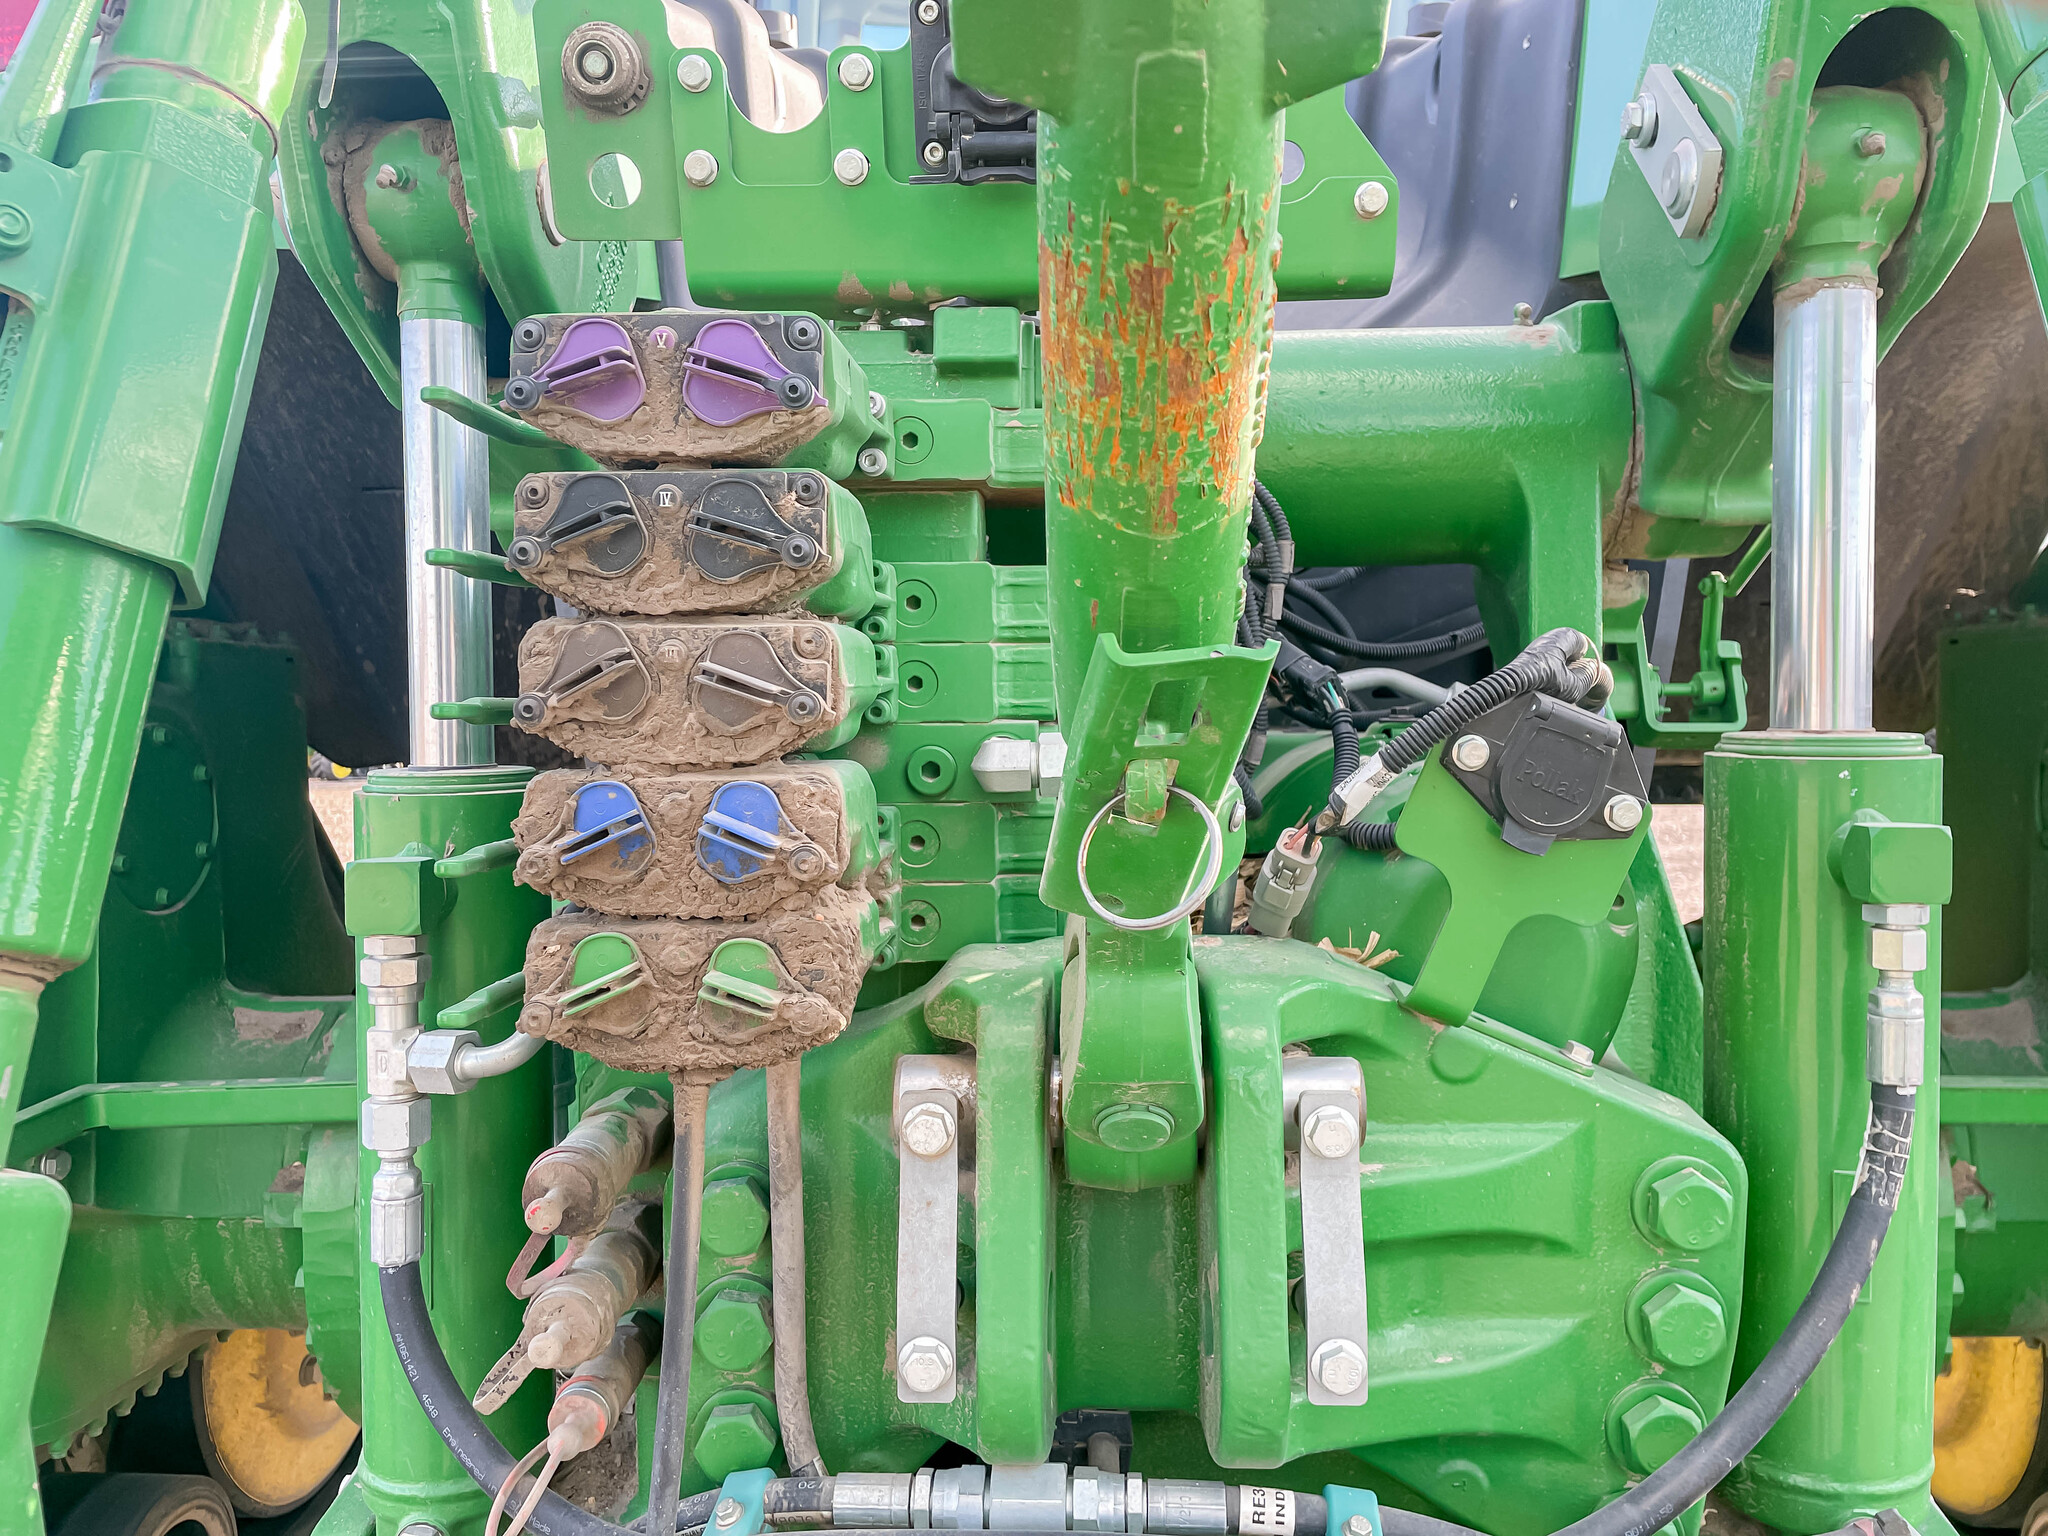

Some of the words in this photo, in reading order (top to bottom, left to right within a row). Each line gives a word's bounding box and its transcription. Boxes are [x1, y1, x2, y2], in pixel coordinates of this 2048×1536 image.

[918, 90, 928, 110] ISO
[655, 332, 668, 349] V
[658, 491, 673, 508] IV
[1515, 758, 1585, 805] Pollak
[421, 1393, 439, 1419] 4648
[442, 1426, 486, 1481] Engineered
[1275, 1491, 1286, 1525] IND
[528, 1514, 551, 1536] Made
